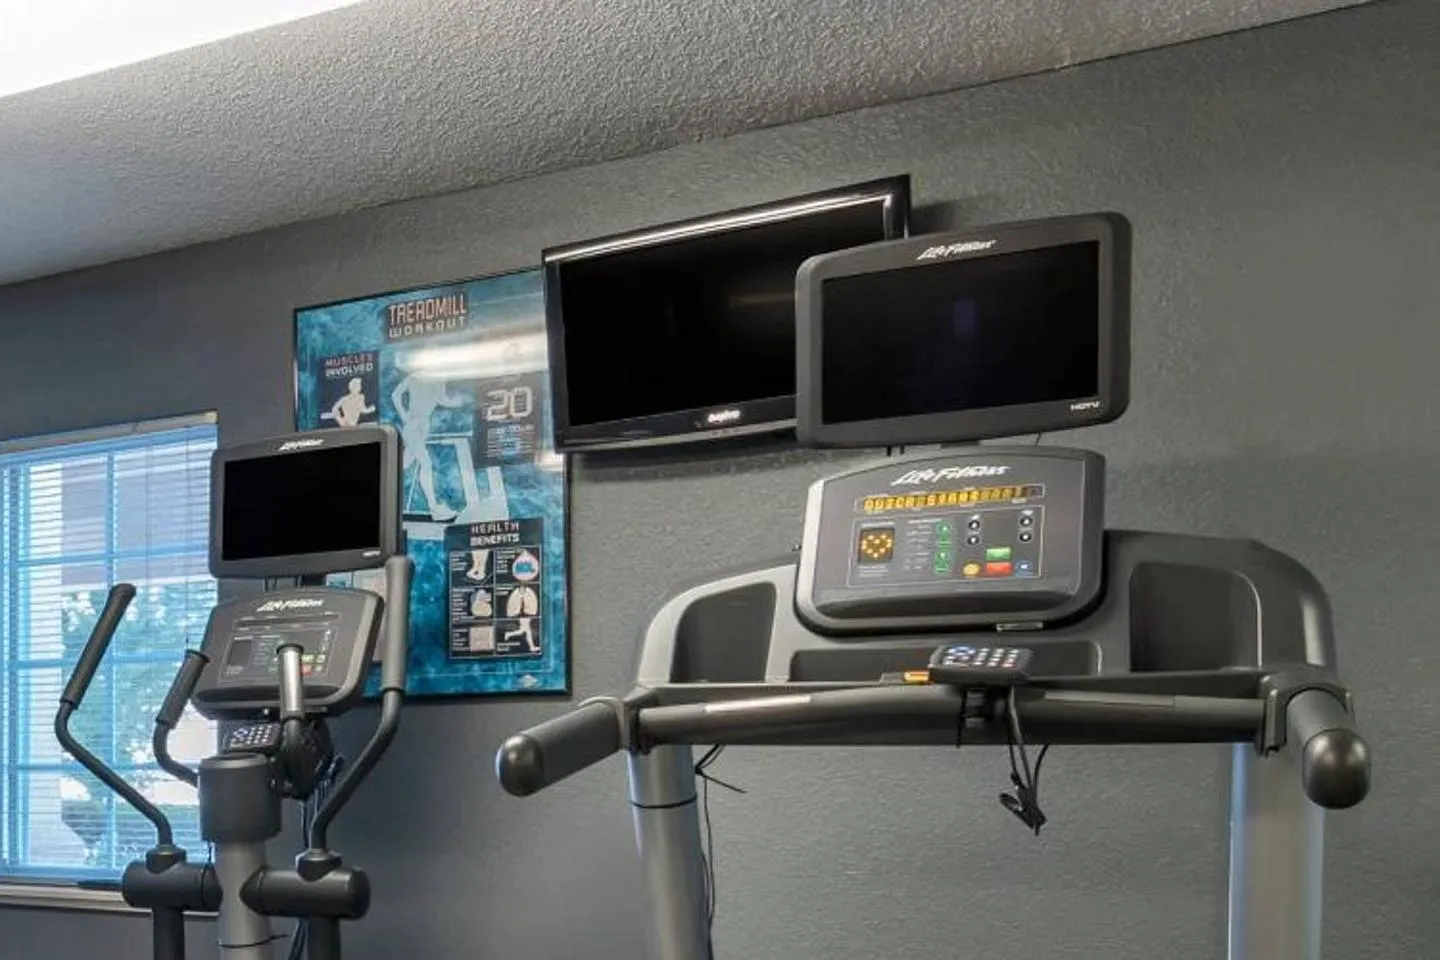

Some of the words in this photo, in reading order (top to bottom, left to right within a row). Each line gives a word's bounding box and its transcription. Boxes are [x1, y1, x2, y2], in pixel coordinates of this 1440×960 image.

[388, 293, 467, 326] TREADMILL
[389, 316, 465, 339] WORKOUT
[326, 362, 374, 377] INVOLVED
[485, 385, 533, 421] 20
[471, 521, 519, 534] HEALTH
[470, 533, 520, 547] BENEFITS
